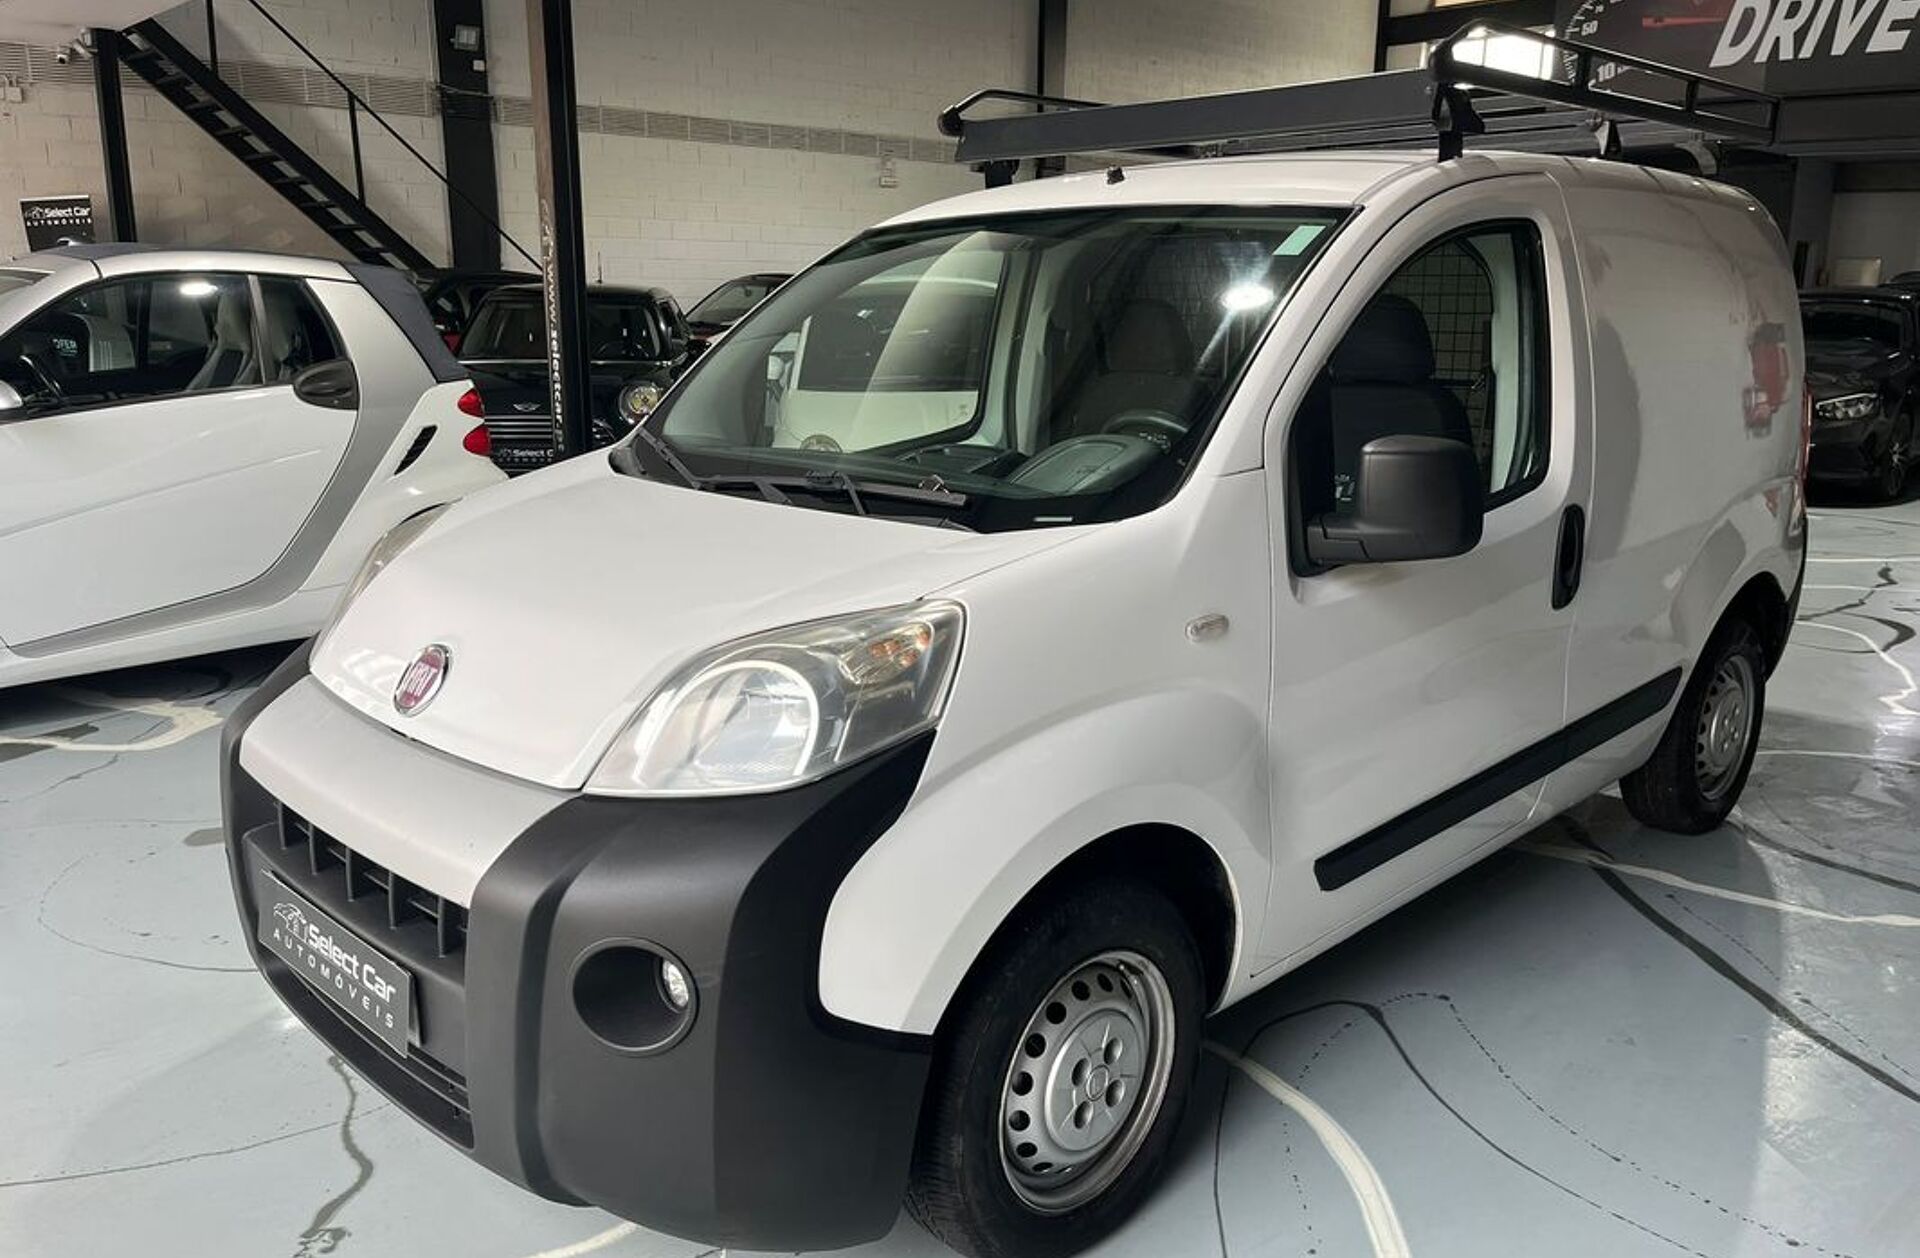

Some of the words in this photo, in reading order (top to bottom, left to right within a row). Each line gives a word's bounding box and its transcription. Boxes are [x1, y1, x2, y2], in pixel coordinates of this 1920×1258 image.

[1709, 0, 1920, 68] DRIVE
[1597, 62, 1616, 82] 10
[44, 207, 73, 218] Select
[73, 206, 91, 216] Car
[512, 448, 546, 457] Select
[403, 661, 438, 697] FIAT
[273, 929, 394, 1028] AUTOMÓVEIS
[308, 924, 360, 979] Select
[362, 964, 396, 1002] Car
